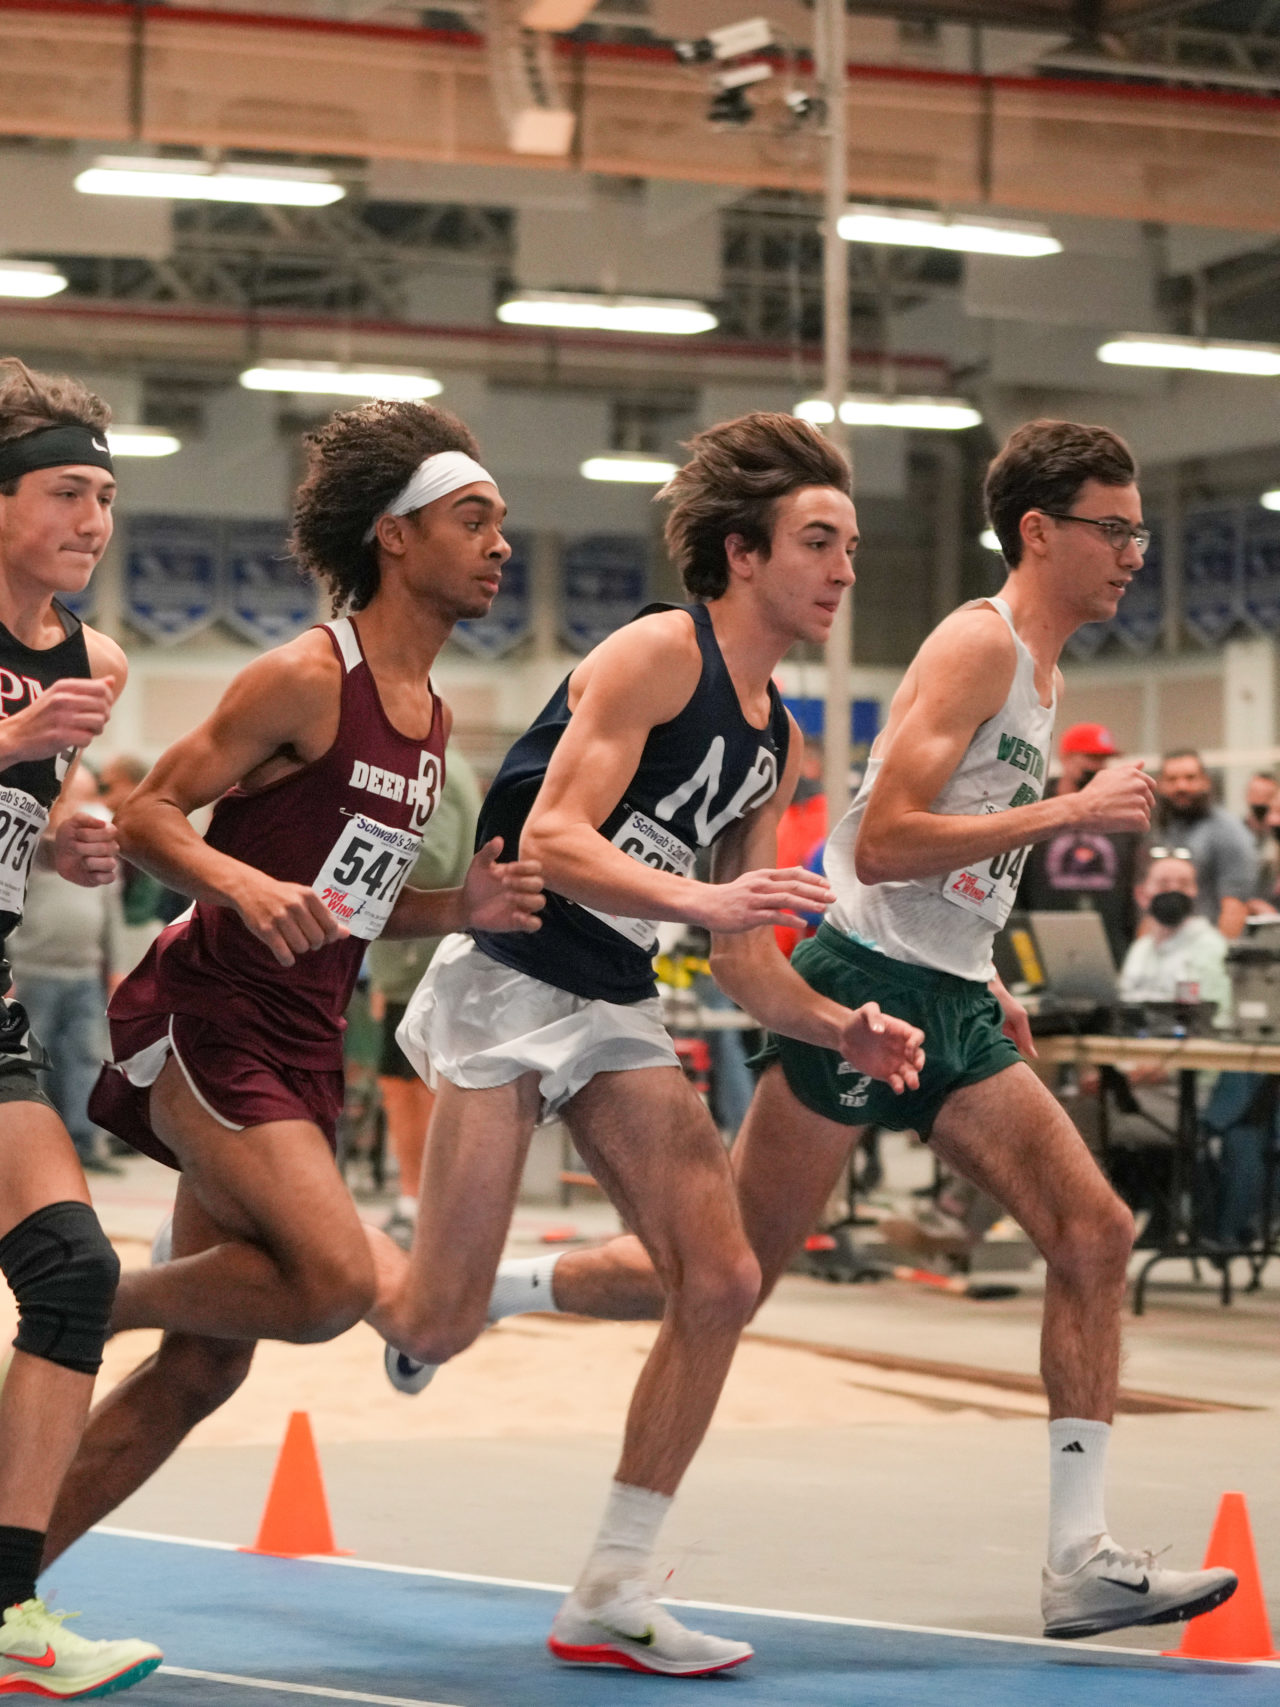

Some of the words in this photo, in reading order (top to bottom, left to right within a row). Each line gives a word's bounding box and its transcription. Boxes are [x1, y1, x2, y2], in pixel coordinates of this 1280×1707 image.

[348, 760, 406, 803] DEER
[416, 758, 439, 827] 3
[356, 818, 405, 848] Schwab's
[632, 817, 676, 853] Schwab's
[327, 898, 354, 918] WIND
